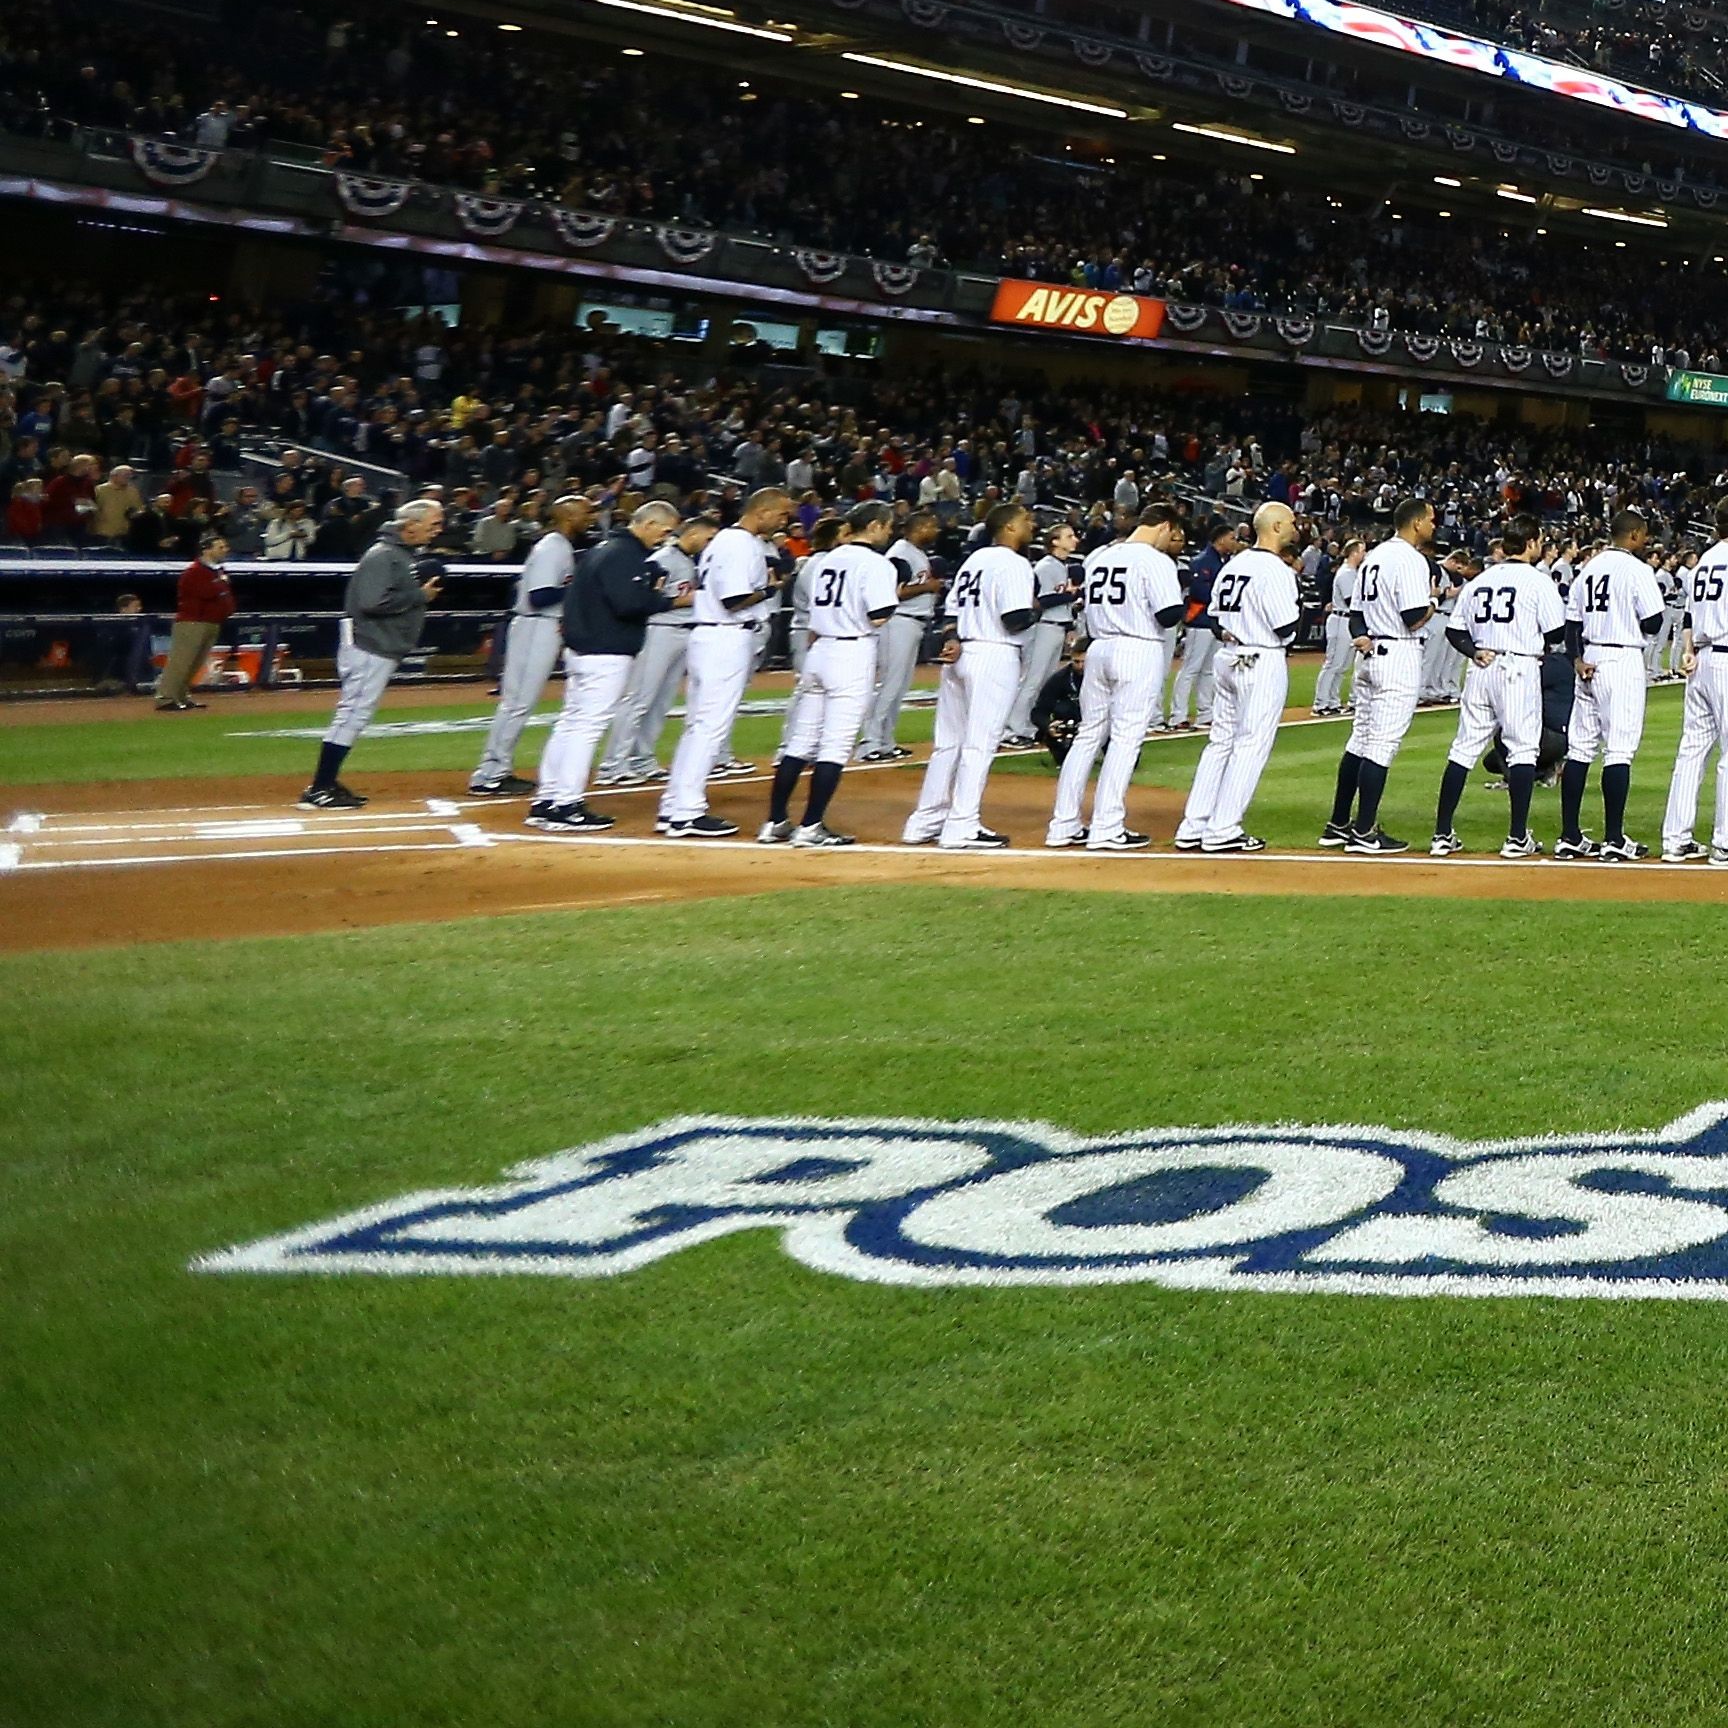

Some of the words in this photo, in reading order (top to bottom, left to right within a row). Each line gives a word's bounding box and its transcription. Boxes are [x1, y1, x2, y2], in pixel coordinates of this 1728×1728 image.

[1016, 288, 1106, 328] AVIS
[1692, 378, 1712, 390] NYSE
[815, 569, 846, 607] 31
[957, 571, 980, 607] 24
[1089, 567, 1127, 604] 25
[1219, 575, 1251, 612] 27
[1361, 565, 1379, 601] 13
[1586, 575, 1609, 612] 14
[1694, 566, 1726, 602] 65
[1474, 587, 1516, 623] 33
